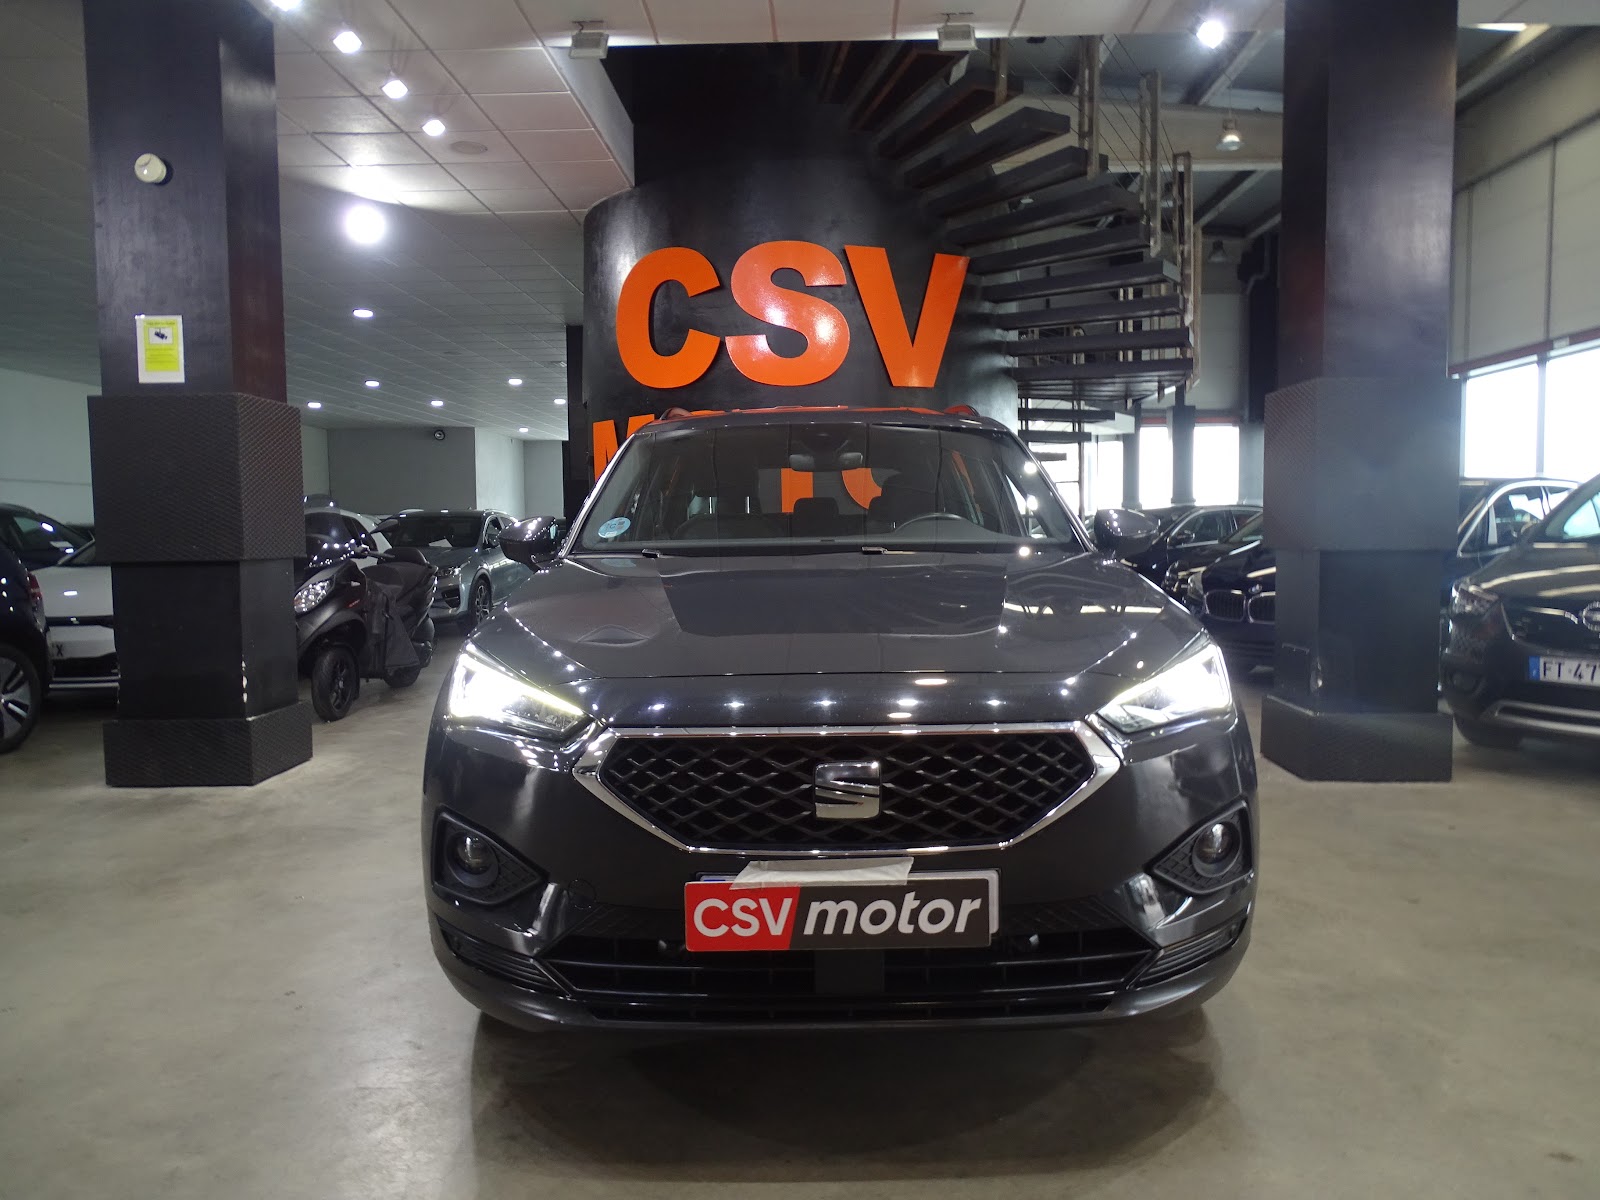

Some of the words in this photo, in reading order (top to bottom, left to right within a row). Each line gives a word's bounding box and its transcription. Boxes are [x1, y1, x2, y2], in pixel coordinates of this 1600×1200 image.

[616, 240, 970, 389] CSV
[1573, 663, 1600, 682] 47
[693, 898, 793, 937] CSV
[803, 891, 981, 936] motor
